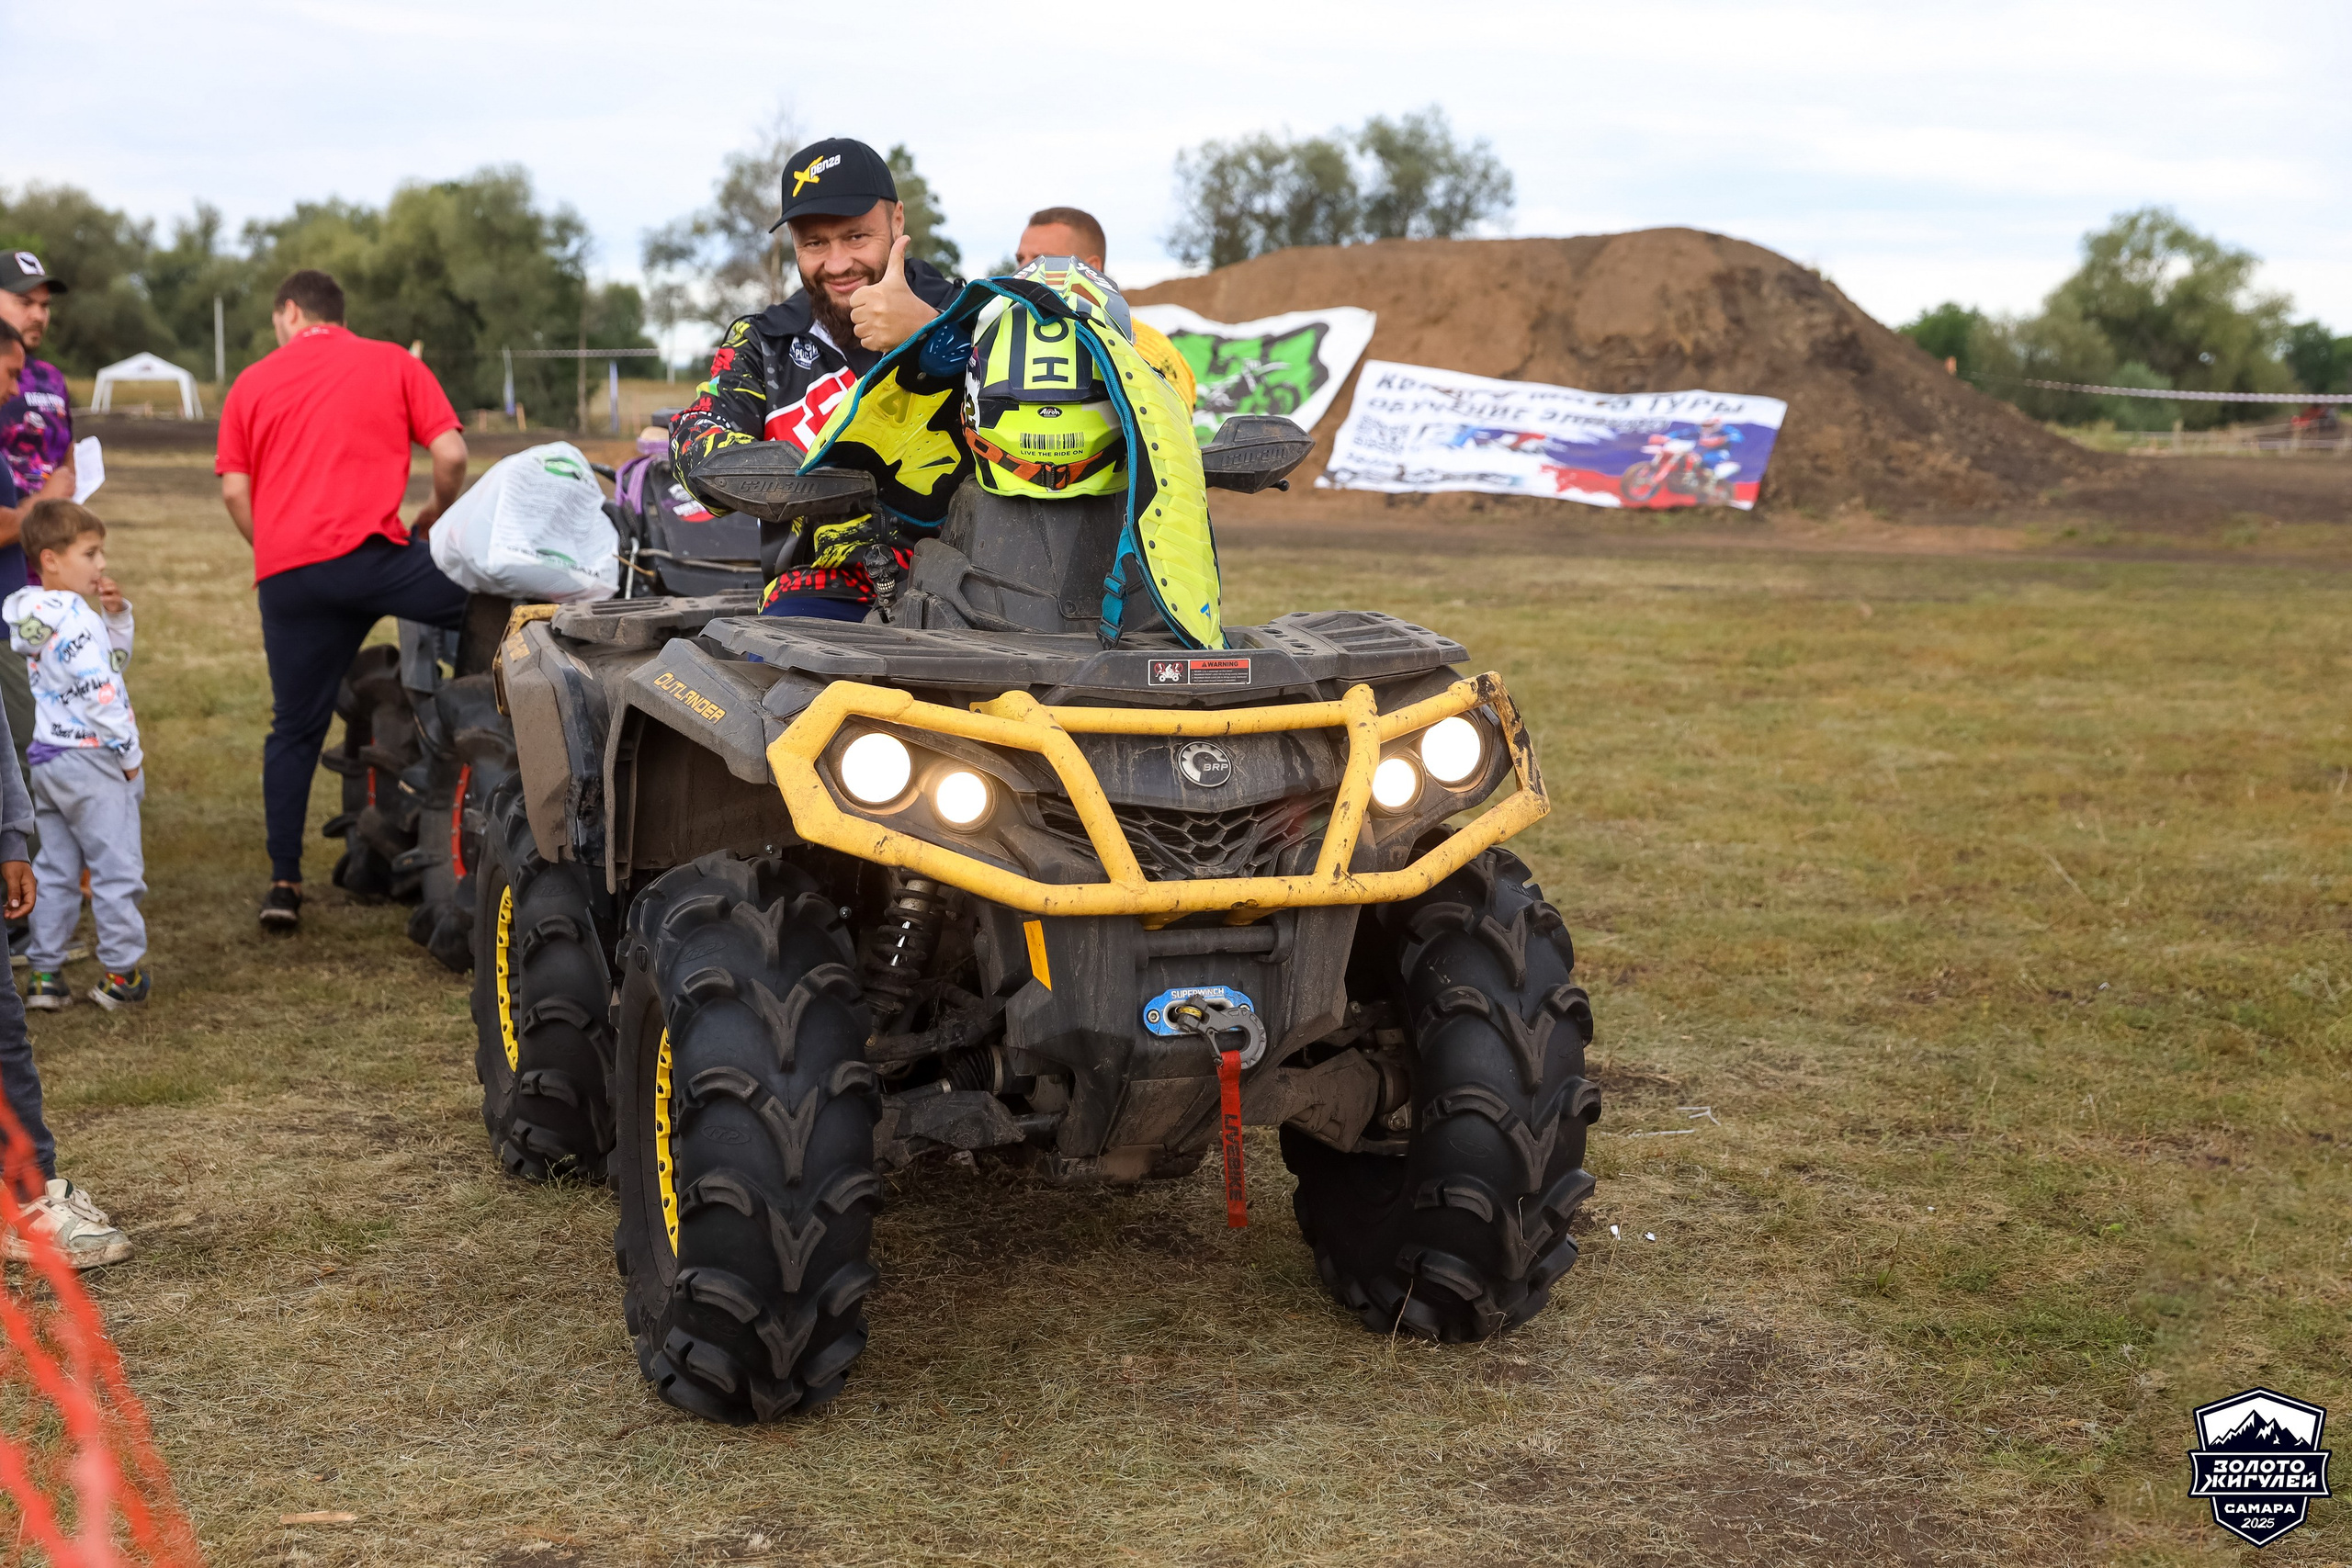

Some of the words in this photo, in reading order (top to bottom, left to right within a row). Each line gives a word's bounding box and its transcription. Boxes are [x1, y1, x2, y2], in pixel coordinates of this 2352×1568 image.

[1039, 407, 1060, 415] Airoh
[738, 478, 818, 494] can-am
[653, 672, 727, 725] OUTLANDER
[1204, 763, 1228, 772] BRP
[1171, 987, 1225, 999] SUPERWINCH
[1224, 1113, 1243, 1201] LIVEBIKE
